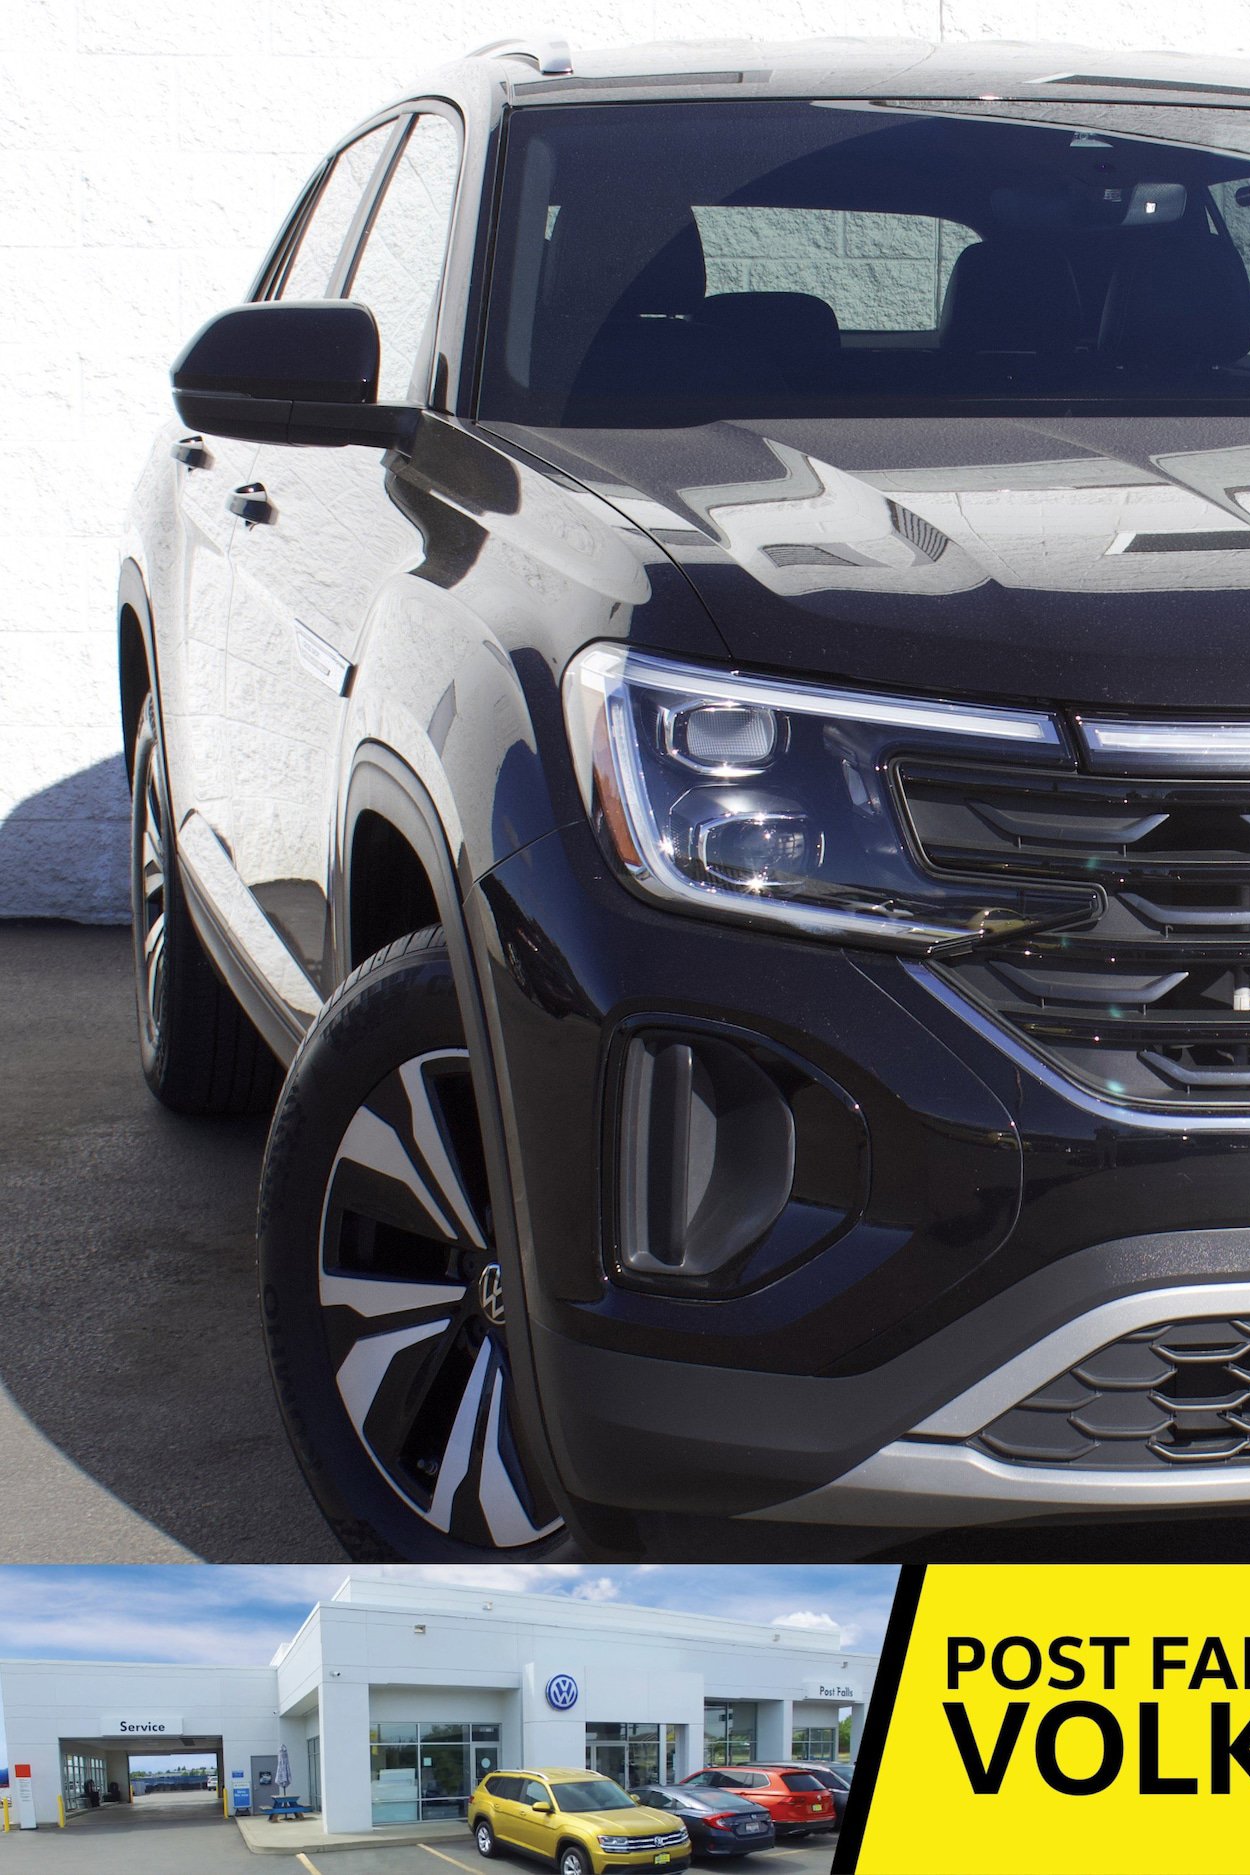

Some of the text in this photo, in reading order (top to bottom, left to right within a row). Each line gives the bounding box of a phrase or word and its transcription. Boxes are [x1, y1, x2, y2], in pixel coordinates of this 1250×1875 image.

[546, 1674, 578, 1711] VW
[819, 1685, 854, 1698] Post Falls
[119, 1720, 166, 1732] Service
